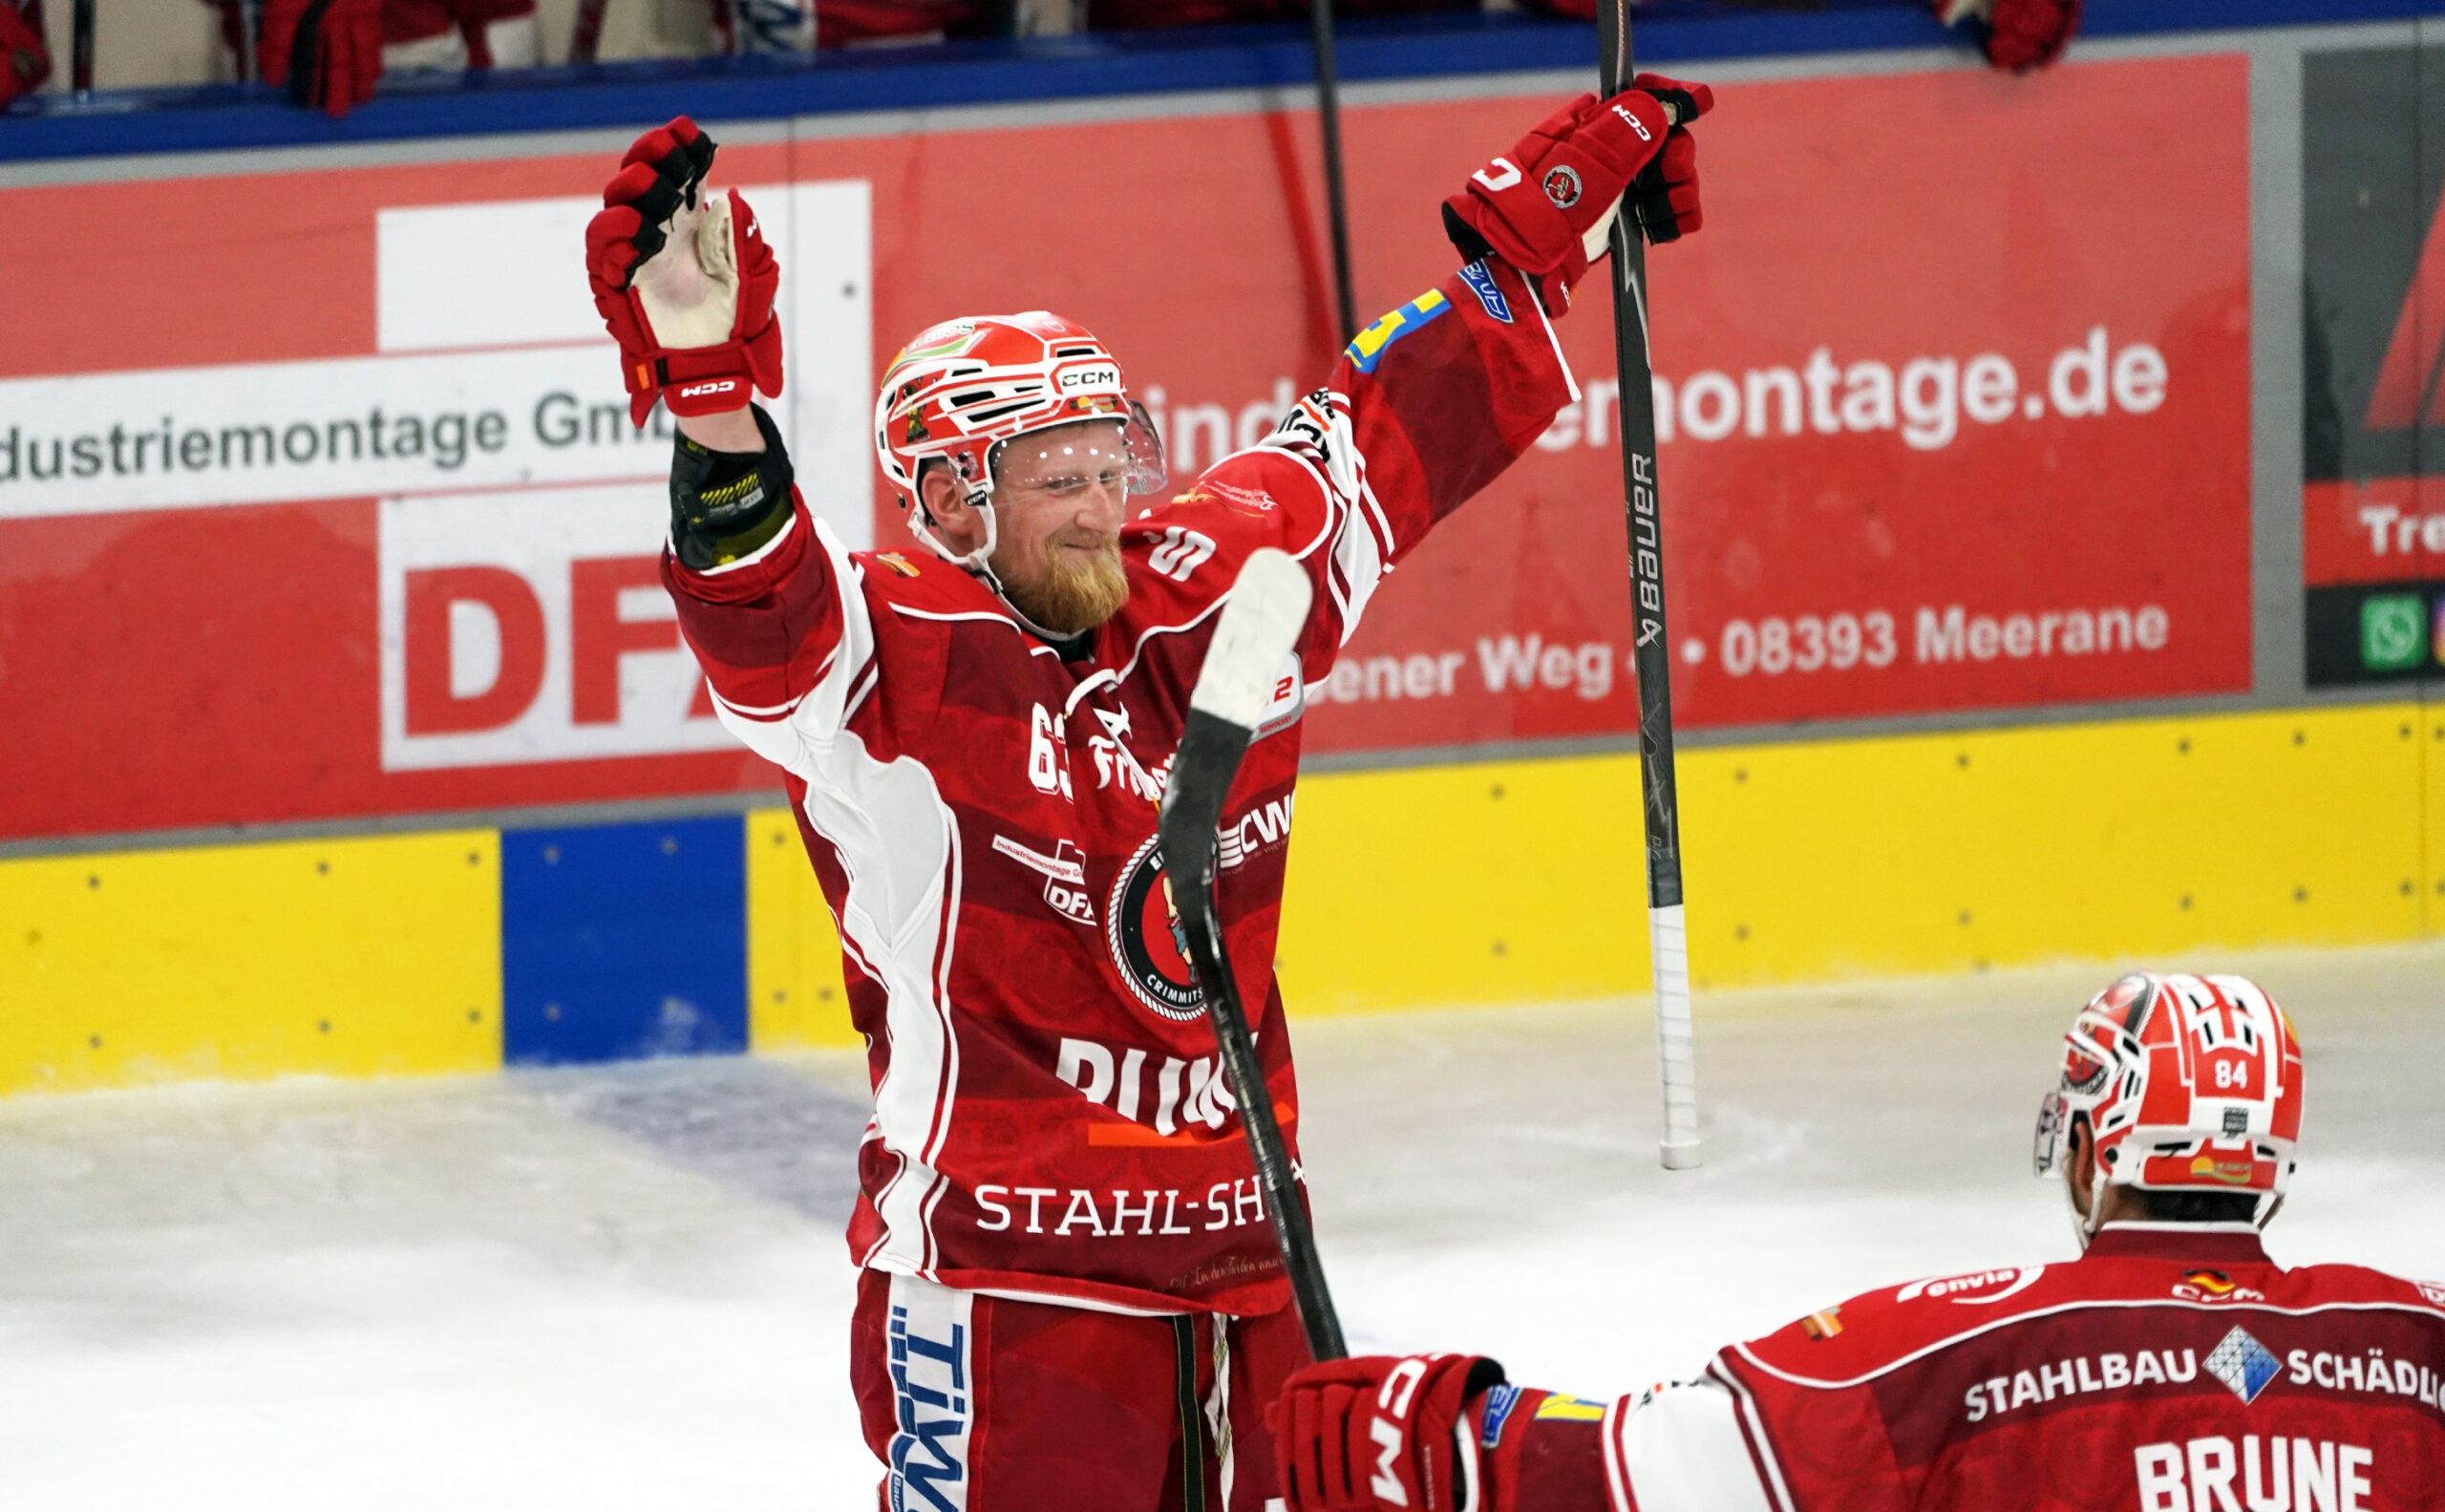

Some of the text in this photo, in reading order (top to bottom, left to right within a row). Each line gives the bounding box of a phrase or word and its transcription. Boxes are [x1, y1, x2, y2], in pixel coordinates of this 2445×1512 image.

[1611, 104, 1650, 141] CCM
[681, 381, 735, 397] CCM
[1061, 371, 1115, 387] CCM
[403, 551, 719, 738] DF
[1477, 633, 1615, 700] Weg
[1722, 612, 1899, 676] 08393
[1916, 604, 2169, 663] Meerane
[2214, 1058, 2248, 1089] 84
[1964, 1349, 2198, 1422] STAHLBAU
[2134, 1434, 2374, 1512] BRUNE
